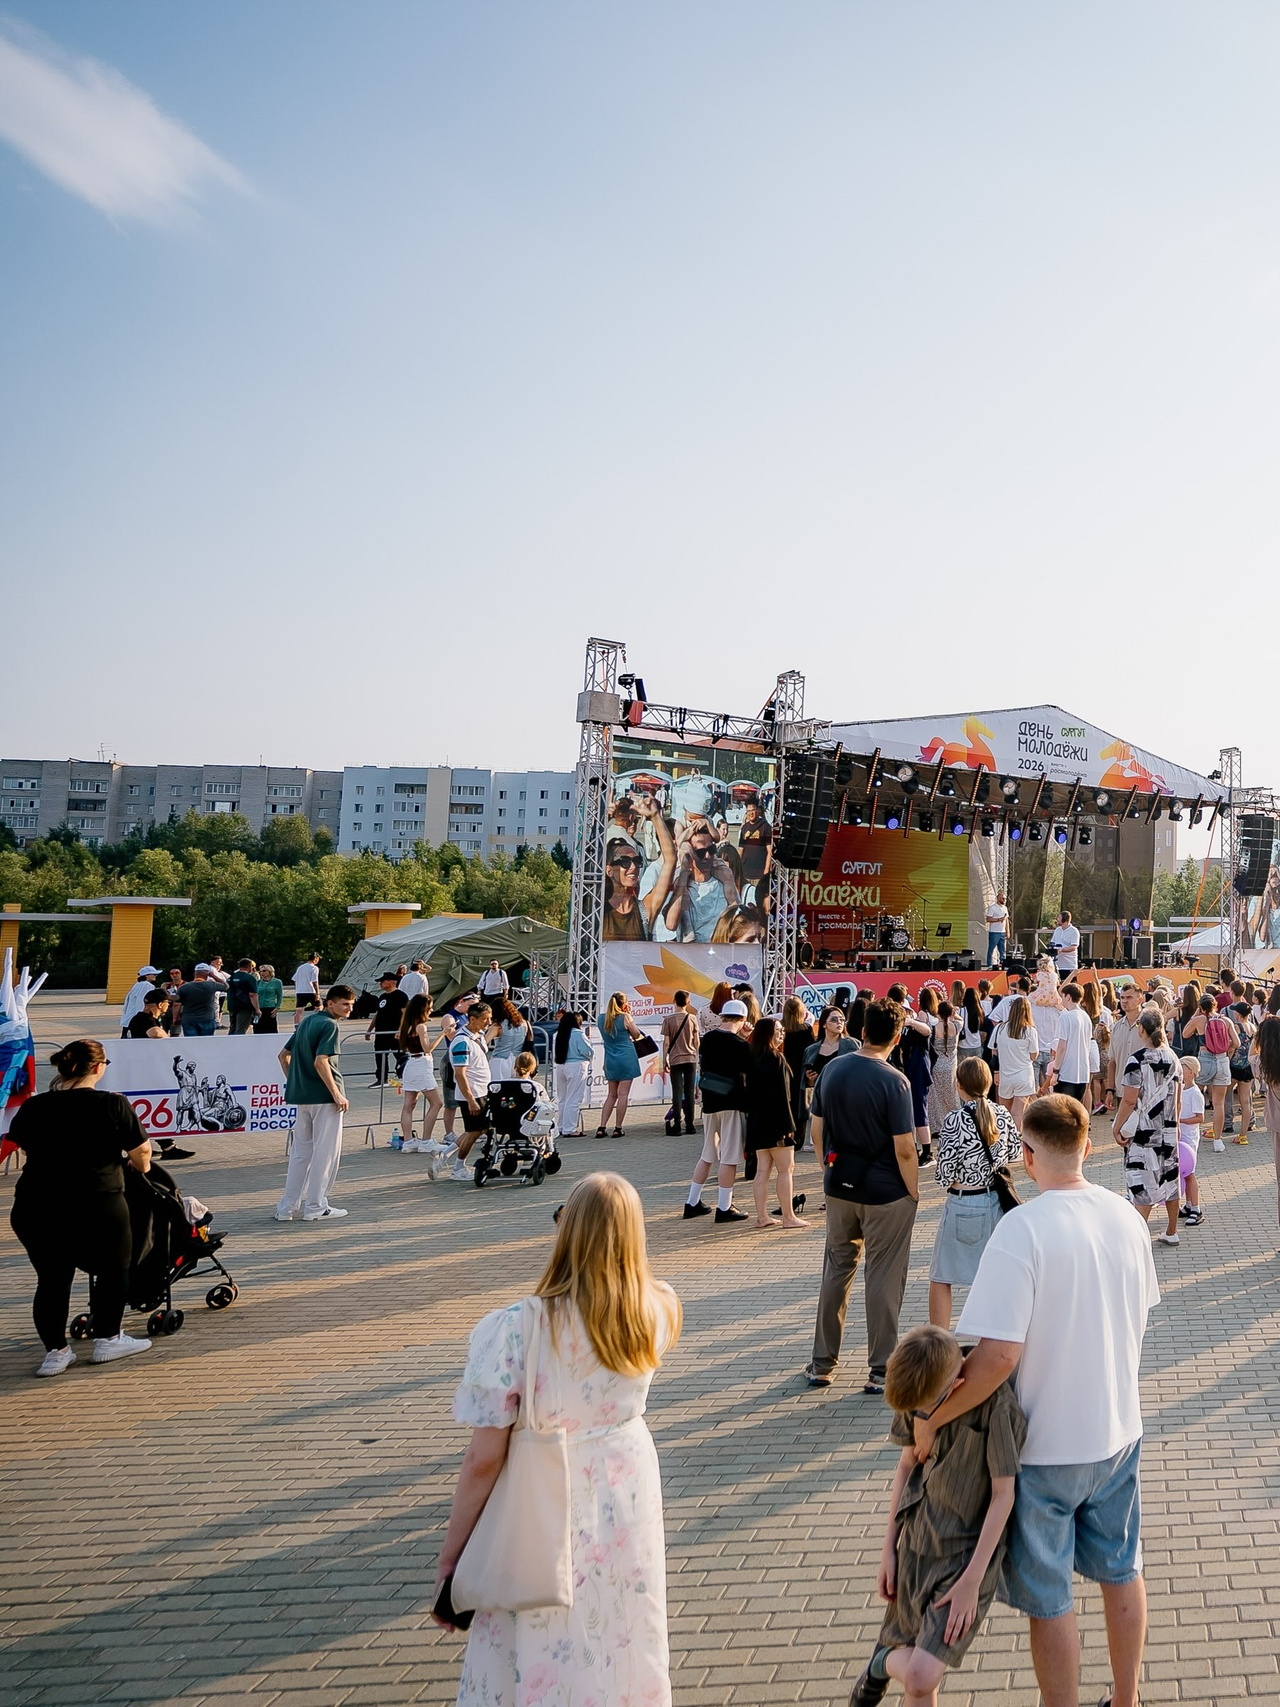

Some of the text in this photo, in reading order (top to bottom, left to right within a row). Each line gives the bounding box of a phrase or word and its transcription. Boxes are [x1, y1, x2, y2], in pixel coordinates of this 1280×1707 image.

[1061, 727, 1086, 738] СУРГУТ
[1018, 758, 1044, 772] 2026
[841, 861, 883, 875] СУРГУТ
[251, 1084, 280, 1096] ГОД
[250, 1097, 287, 1108] ЕДИН
[131, 1098, 173, 1129] 26
[250, 1107, 297, 1119] НАРОД
[250, 1119, 297, 1132] РОССИ
